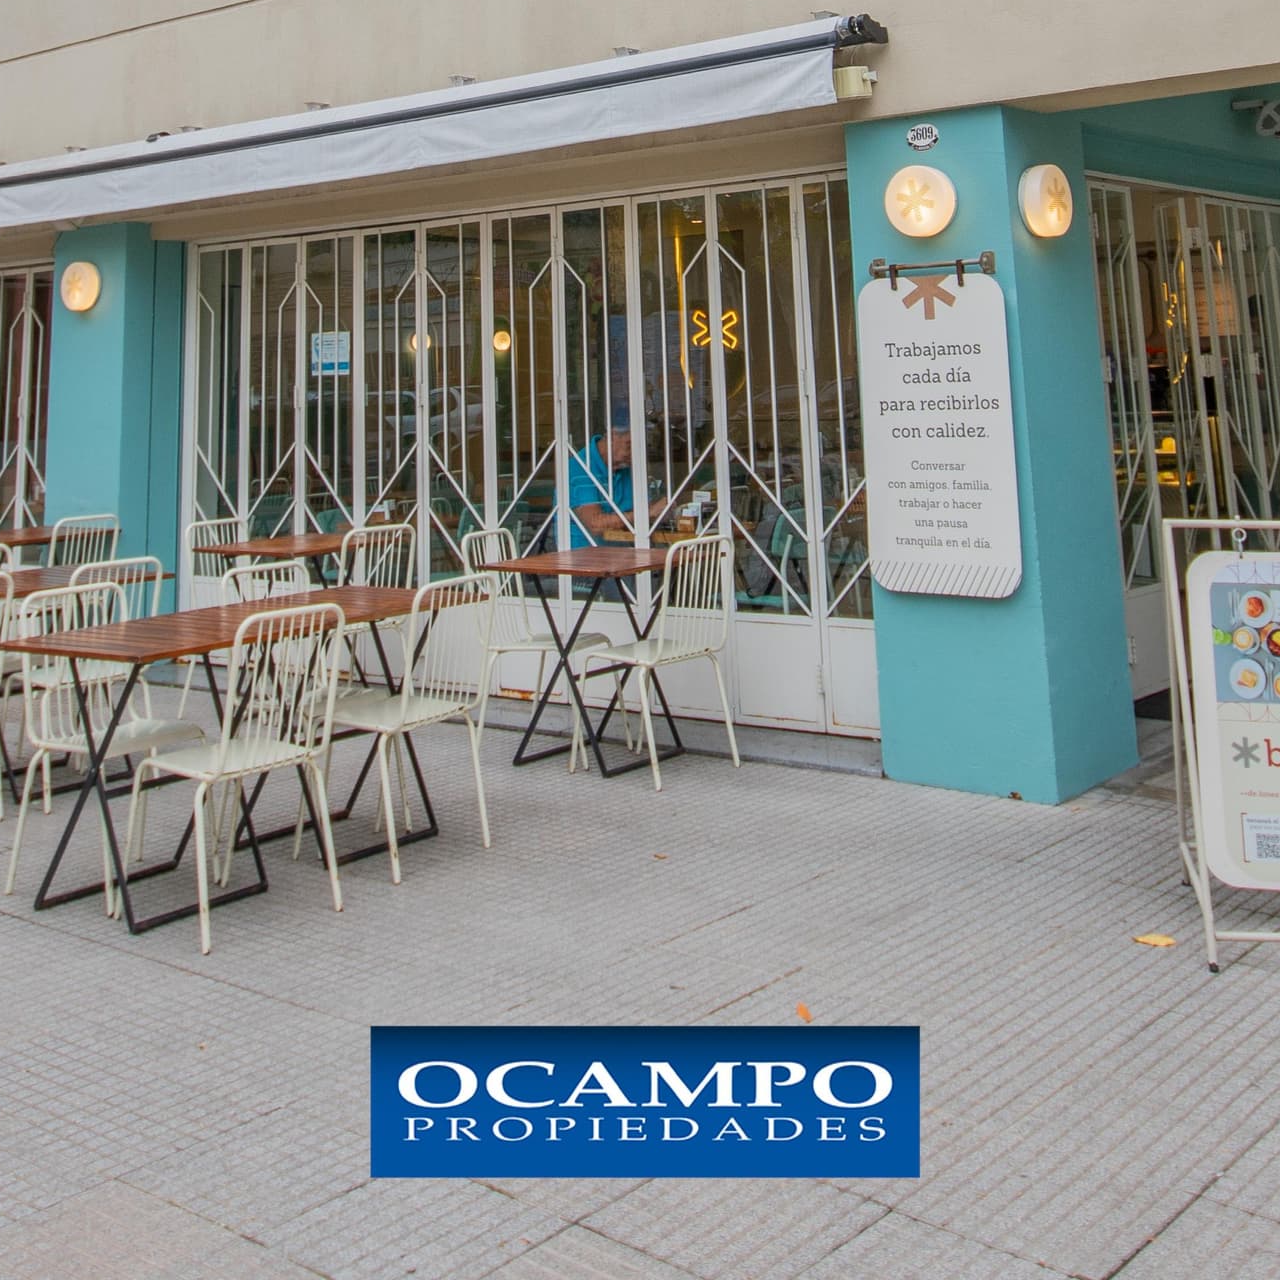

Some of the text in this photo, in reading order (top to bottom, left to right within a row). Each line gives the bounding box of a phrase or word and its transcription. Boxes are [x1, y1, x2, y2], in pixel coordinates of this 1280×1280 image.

[910, 126, 934, 141] 3609
[884, 341, 982, 360] Trabajamos
[902, 365, 971, 384] cada día
[879, 394, 1000, 416] para recibirlos
[892, 422, 990, 439] con calidez.
[911, 460, 966, 471] Conversar
[887, 480, 907, 489] con
[898, 498, 982, 511] trabajar o hacer
[914, 519, 968, 530] una pausa
[895, 536, 943, 549] tranquila
[945, 539, 959, 548] en
[961, 537, 971, 548] el
